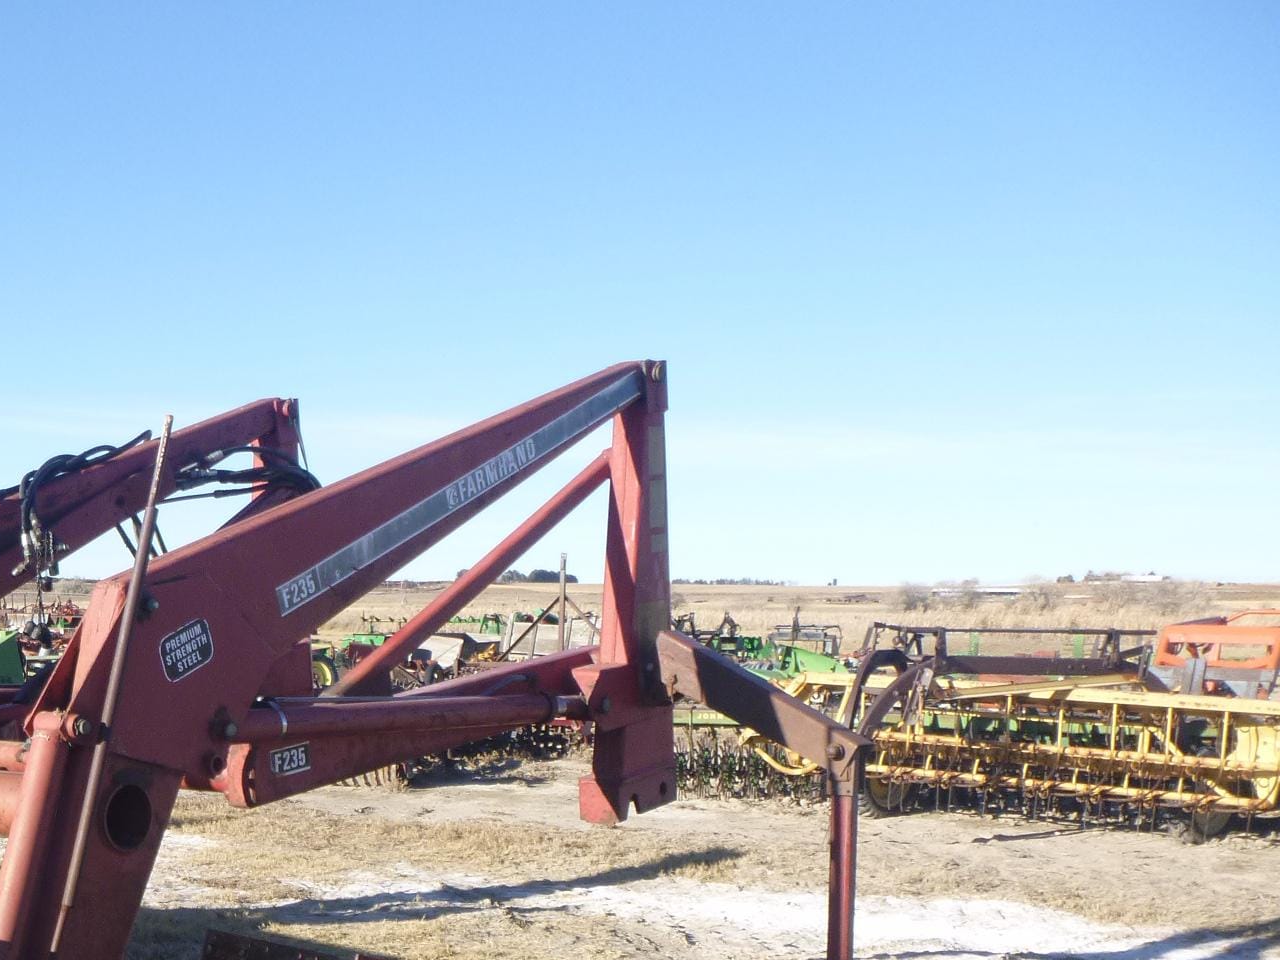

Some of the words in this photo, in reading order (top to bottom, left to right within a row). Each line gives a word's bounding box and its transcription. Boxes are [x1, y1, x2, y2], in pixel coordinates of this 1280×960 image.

[458, 439, 536, 502] FARMHAND
[282, 573, 316, 608] F235
[165, 624, 202, 653] PREMIUM
[166, 633, 208, 665] STRENGTH
[177, 651, 202, 672] STEEL
[274, 747, 306, 773] F235
